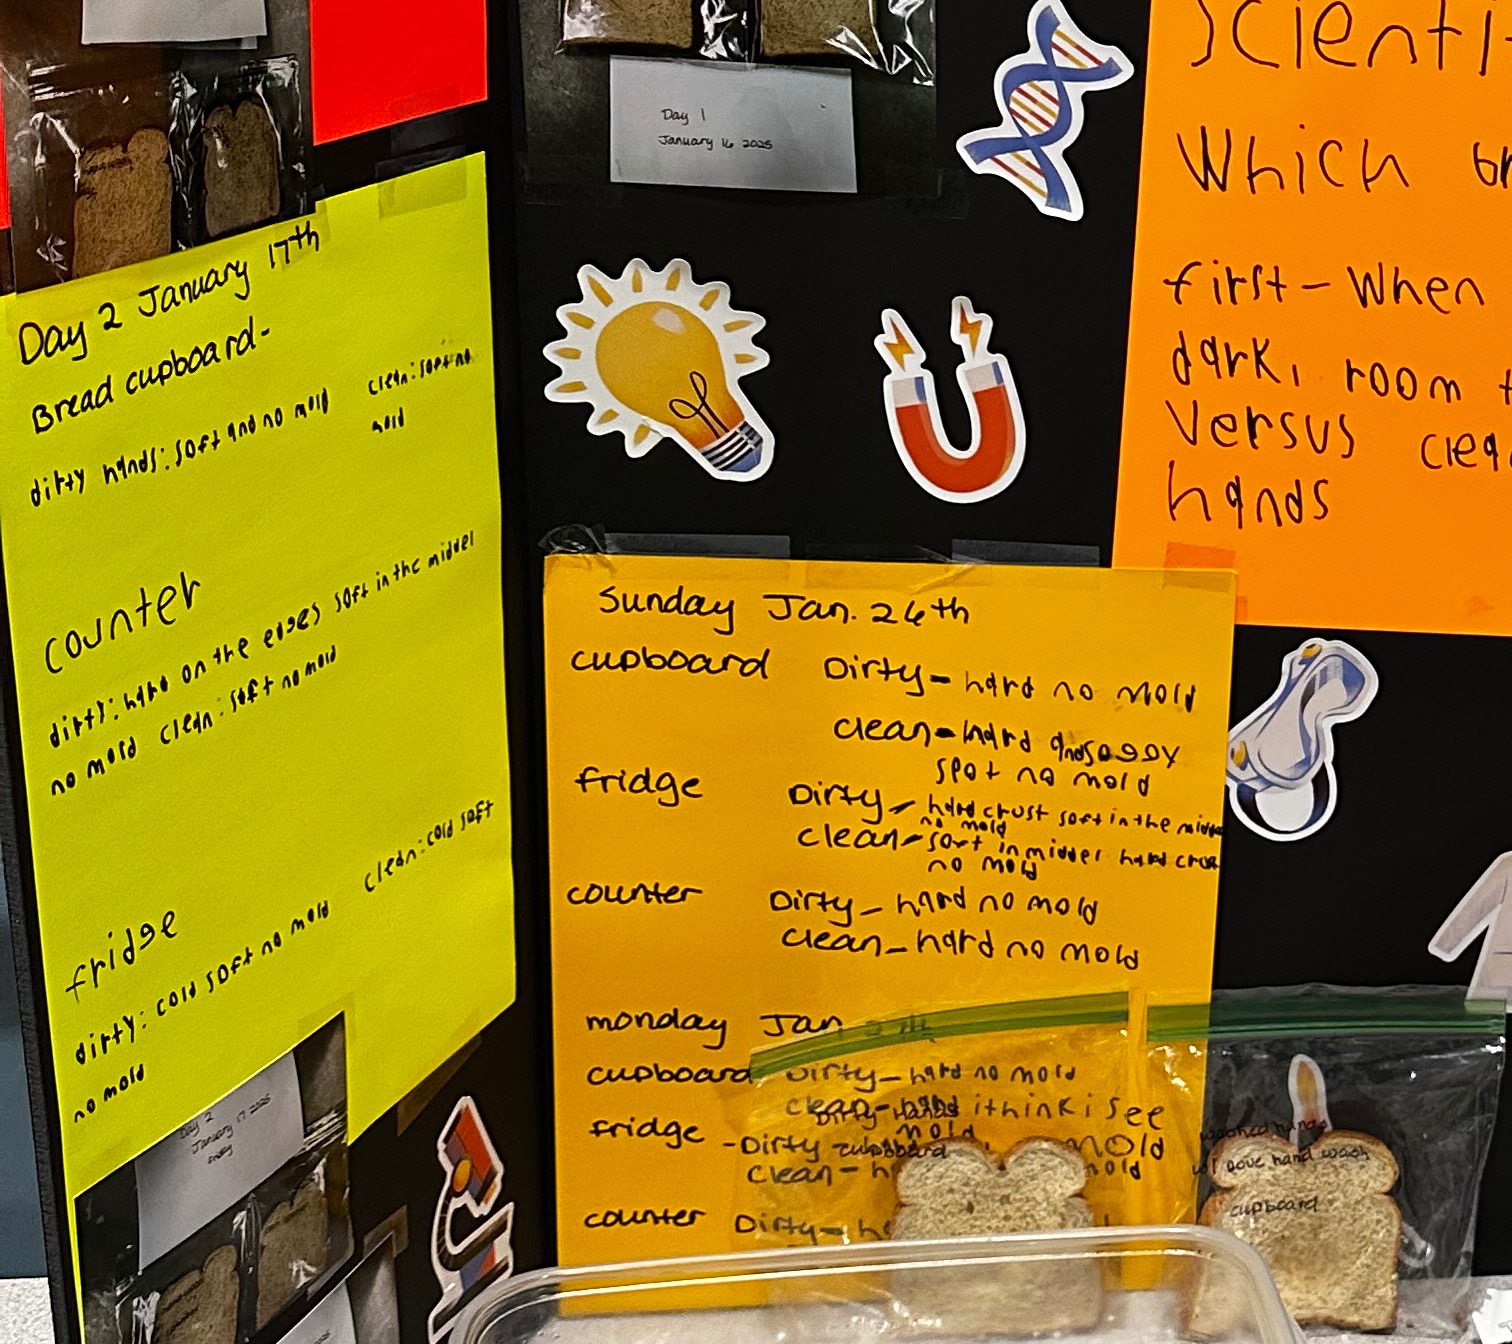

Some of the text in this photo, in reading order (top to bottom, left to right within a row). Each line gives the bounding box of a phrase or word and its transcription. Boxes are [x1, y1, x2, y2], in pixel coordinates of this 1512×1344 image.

[660, 108, 689, 126] Day
[658, 135, 773, 152] January 2025
[18, 220, 320, 366] Day 2 January 17th
[1345, 358, 1461, 403] room
[31, 374, 114, 435] Bread
[30, 468, 85, 508] dirty
[263, 407, 283, 429] no
[1168, 459, 1329, 530] hands
[45, 571, 201, 680] counter
[599, 585, 969, 636] Sunday Jan. 26th
[181, 637, 249, 684] on the
[571, 646, 770, 680] cupboard
[965, 672, 1035, 699] hard
[1053, 681, 1094, 702] no
[51, 771, 76, 796] no
[281, 669, 300, 689] no
[1016, 766, 1055, 787] no
[1072, 771, 1150, 797] mold
[927, 856, 963, 873] no
[566, 882, 1098, 926] counter hard no mold
[261, 931, 282, 956] no
[917, 928, 1139, 971] hard no mold
[73, 1098, 96, 1124] no
[583, 1209, 706, 1229] counter
